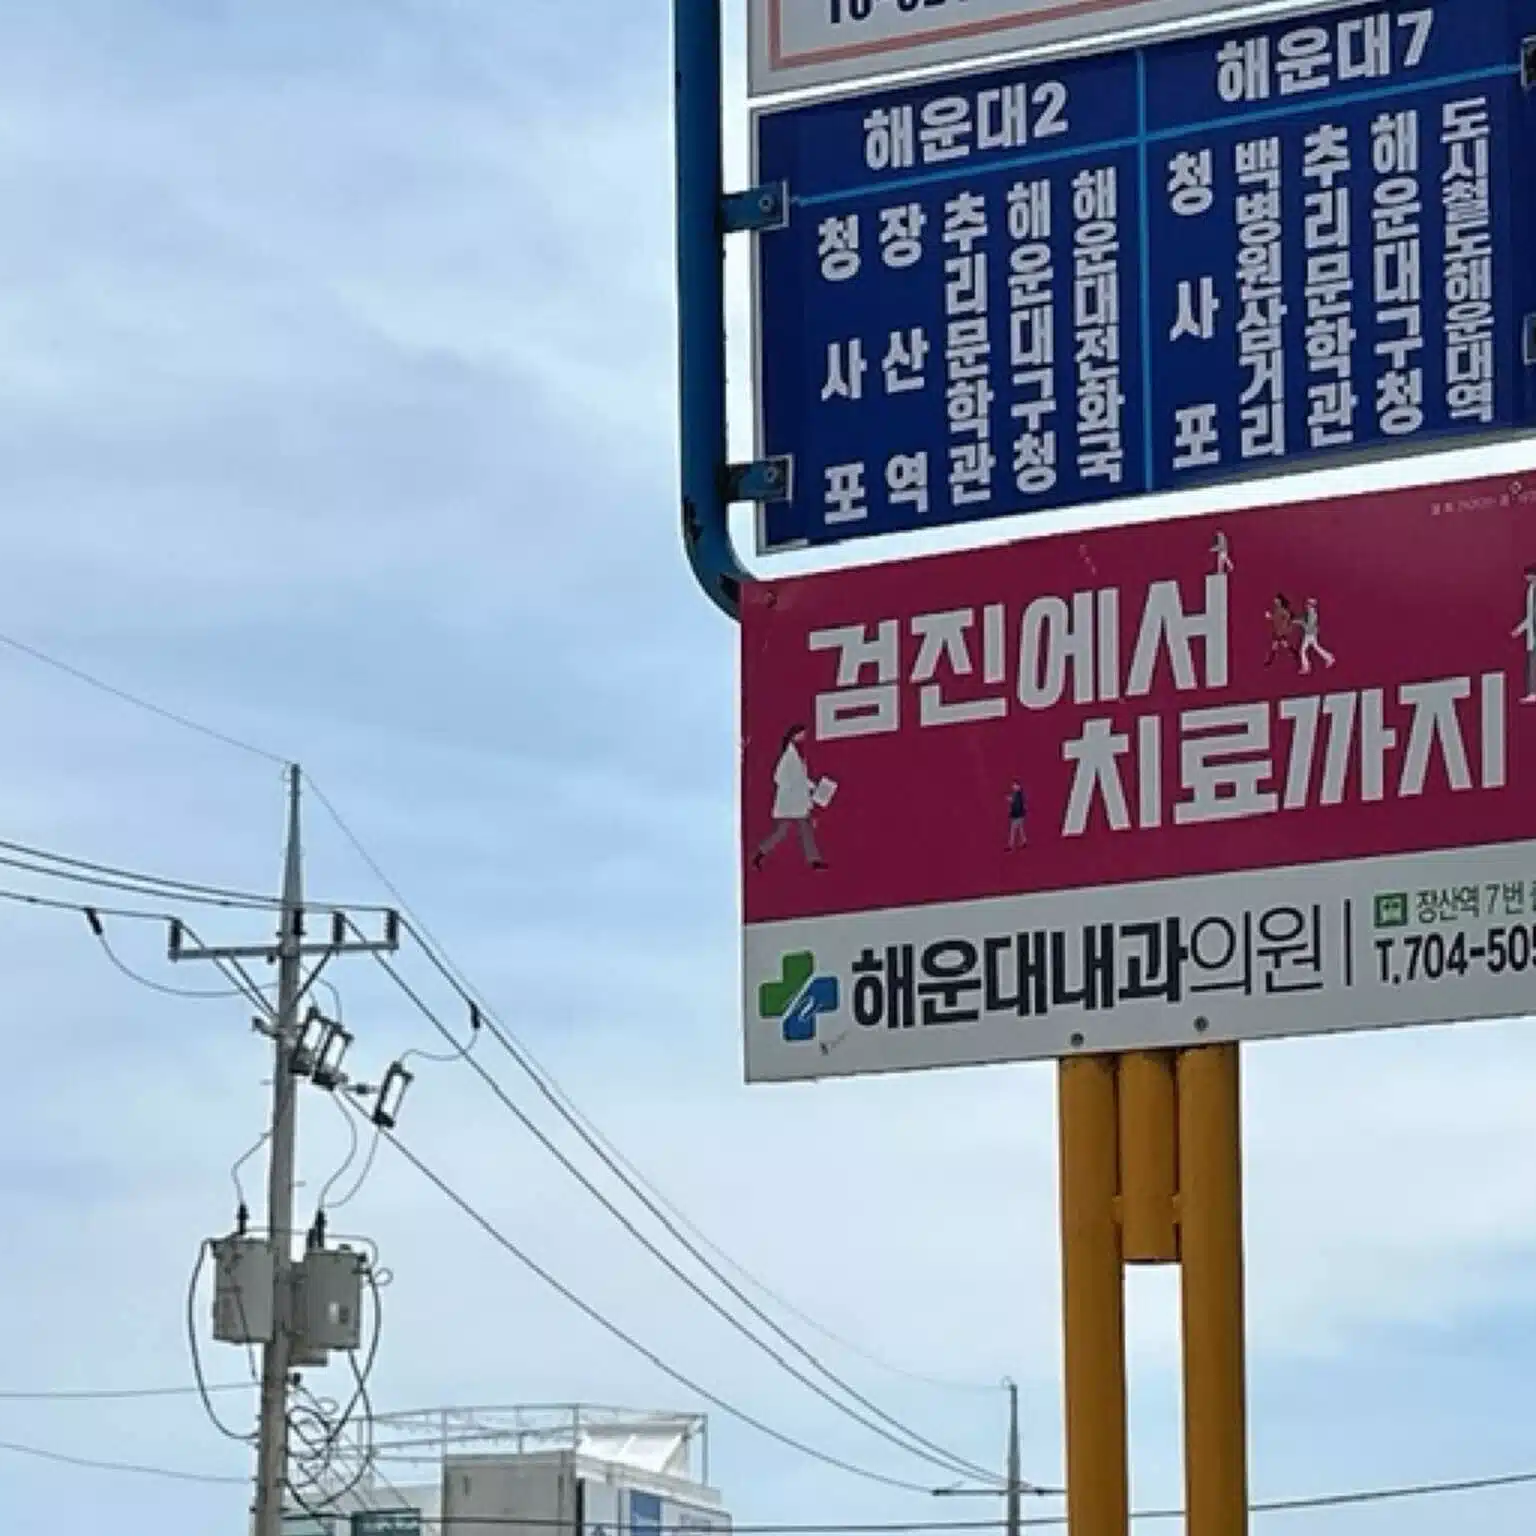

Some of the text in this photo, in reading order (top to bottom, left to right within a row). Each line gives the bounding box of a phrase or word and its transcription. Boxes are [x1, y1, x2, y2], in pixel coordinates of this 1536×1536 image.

[865, 82, 1068, 171] 해운대2
[1218, 8, 1433, 103] 해운대7
[818, 215, 865, 523] 청사포
[880, 207, 928, 513] 장산역
[944, 194, 994, 502] 추리문학관
[1007, 180, 1058, 490] 해운대구청
[1072, 168, 1125, 482] 해운대전화국
[1168, 153, 1219, 468] 청사포
[1234, 138, 1285, 457] 백병원삼거리
[1304, 127, 1355, 445] 추리문학관
[1371, 112, 1423, 435] 해운대구청
[1441, 97, 1494, 422] 도시철도해운대역
[808, 573, 1228, 741] 검진에서
[1063, 673, 1505, 837] 치료까지
[851, 903, 1324, 1030] 해운대내과의원
[1417, 884, 1479, 923] 장산역
[1485, 880, 1524, 915] 7번
